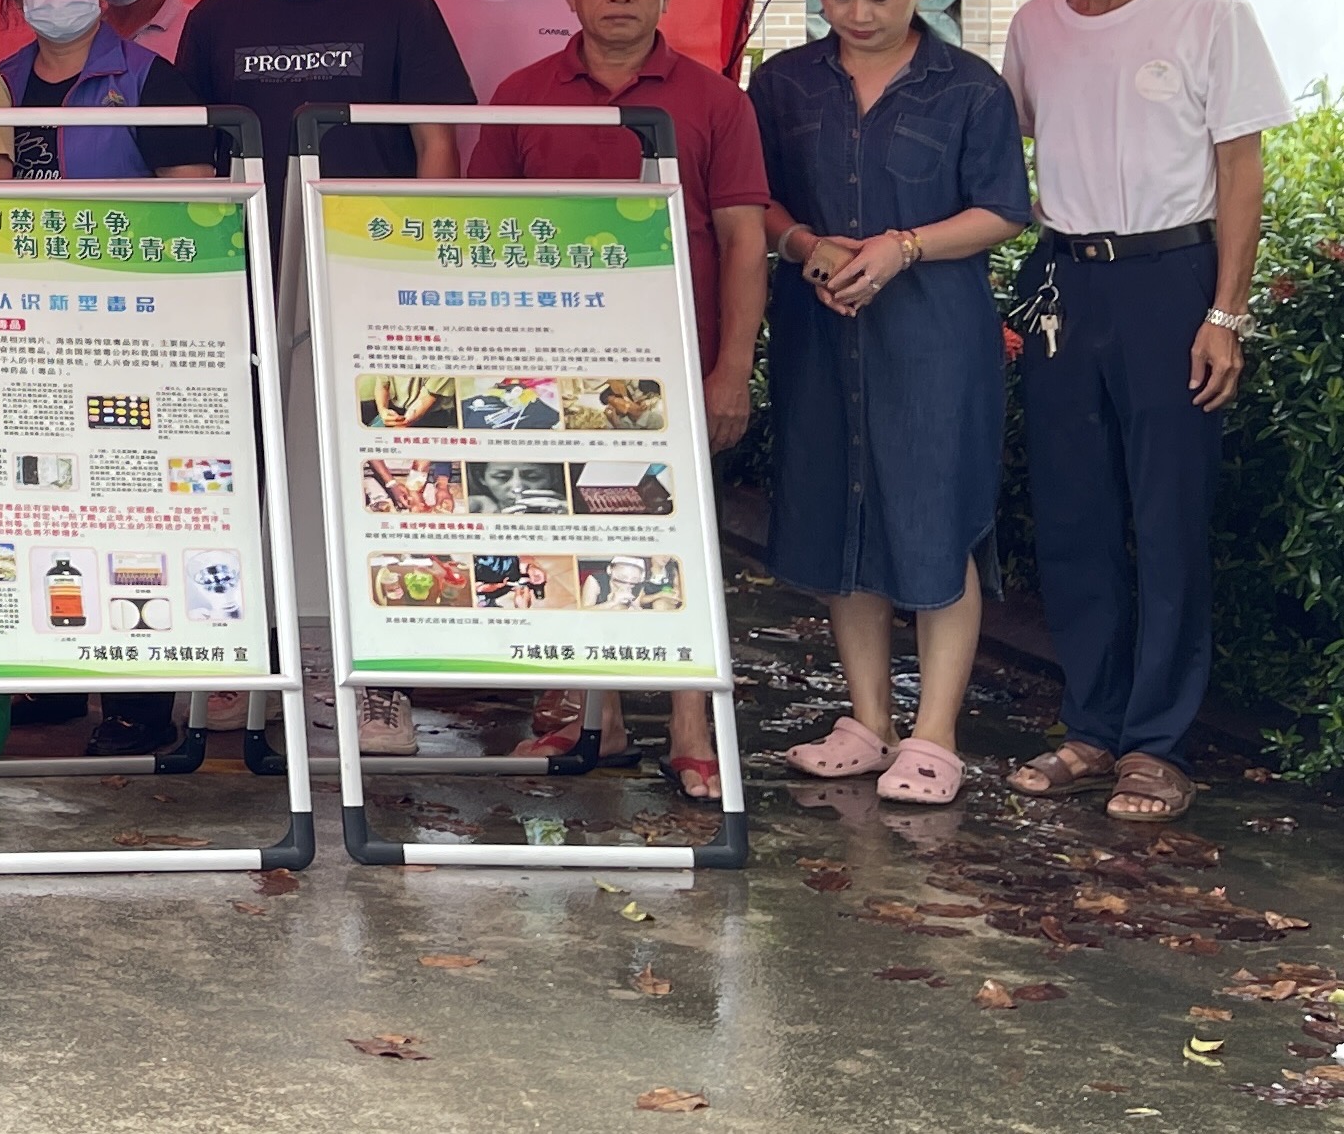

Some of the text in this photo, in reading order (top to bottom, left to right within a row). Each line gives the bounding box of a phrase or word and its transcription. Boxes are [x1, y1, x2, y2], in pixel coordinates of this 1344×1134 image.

[243, 50, 353, 74] PROTECT
[367, 216, 558, 242] 参与禁毒斗争
[13, 235, 198, 263] 构建无毒青春
[436, 243, 629, 269] 构建无毒青春
[397, 289, 607, 308] 吸食毒品的主要形式
[78, 645, 250, 663] 万城镇委 万城镇政府 宣
[510, 644, 694, 663] 万城镇委 万城镇政府 宣
